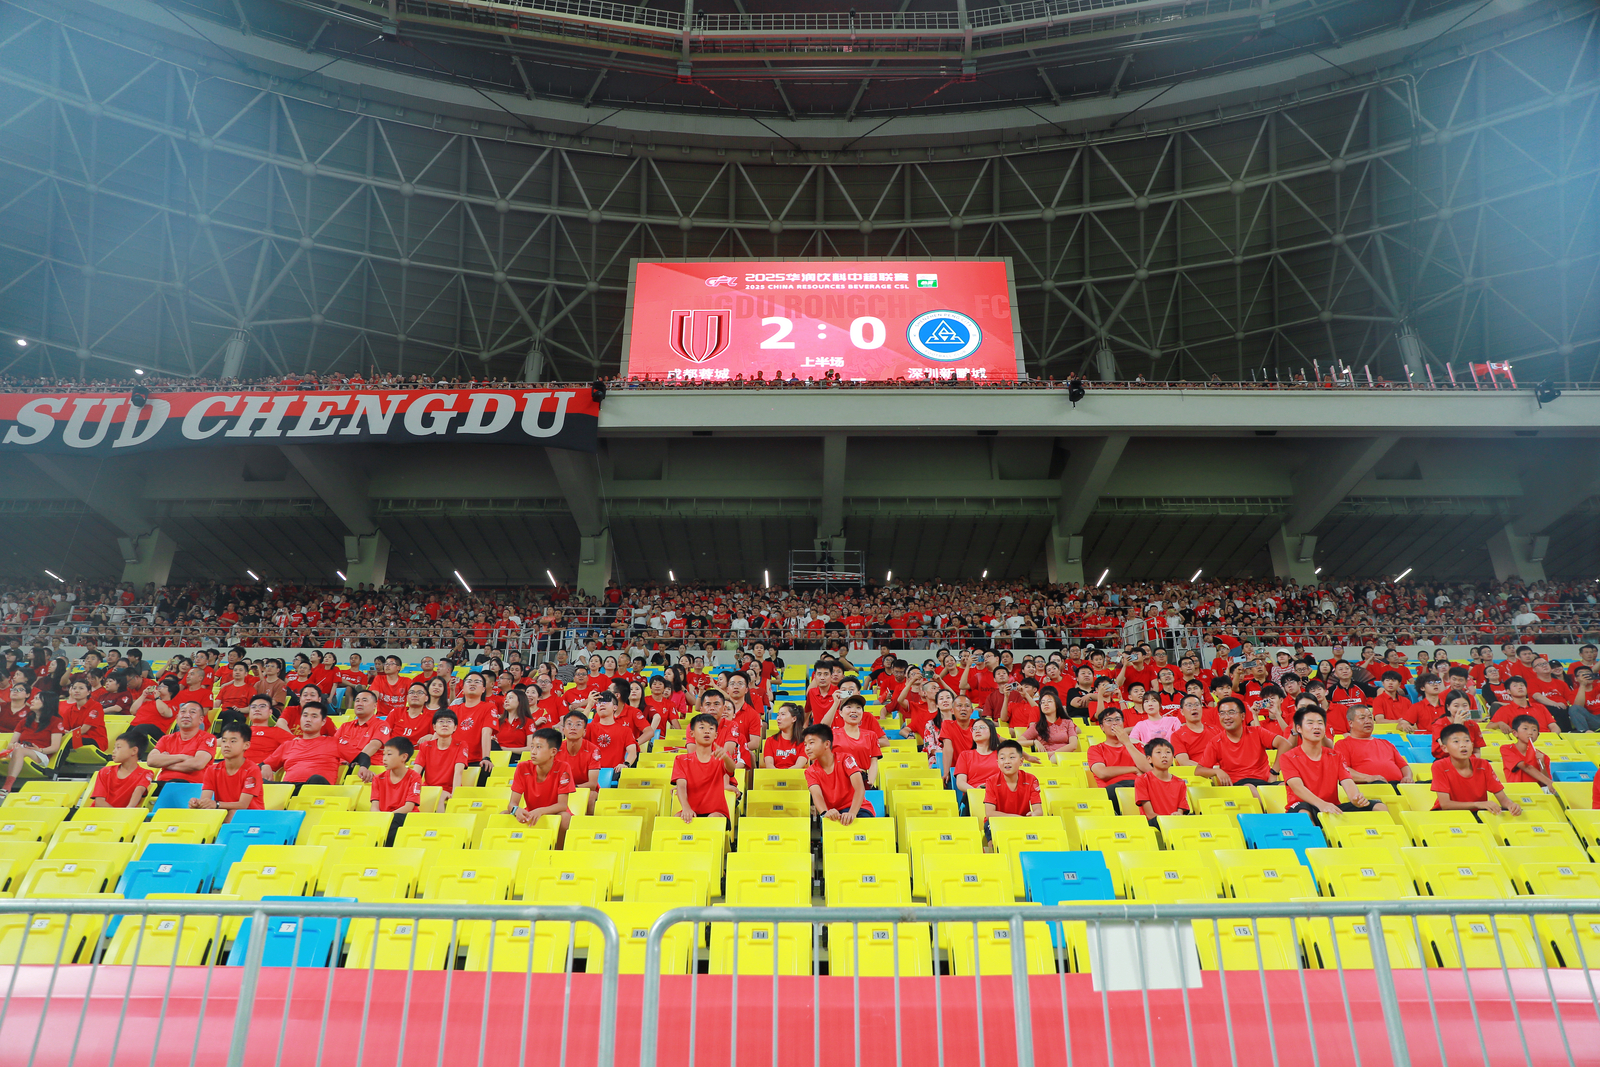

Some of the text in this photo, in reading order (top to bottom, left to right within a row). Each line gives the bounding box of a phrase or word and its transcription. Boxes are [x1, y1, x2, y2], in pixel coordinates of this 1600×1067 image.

[760, 316, 795, 349] 2
[850, 316, 886, 349] 0
[800, 356, 844, 367] 上半场
[668, 368, 730, 379] 成都蓉城
[908, 368, 987, 379] 深圳新鹏城
[2, 392, 576, 448] SUD CHENGDU
[403, 728, 412, 736] 19
